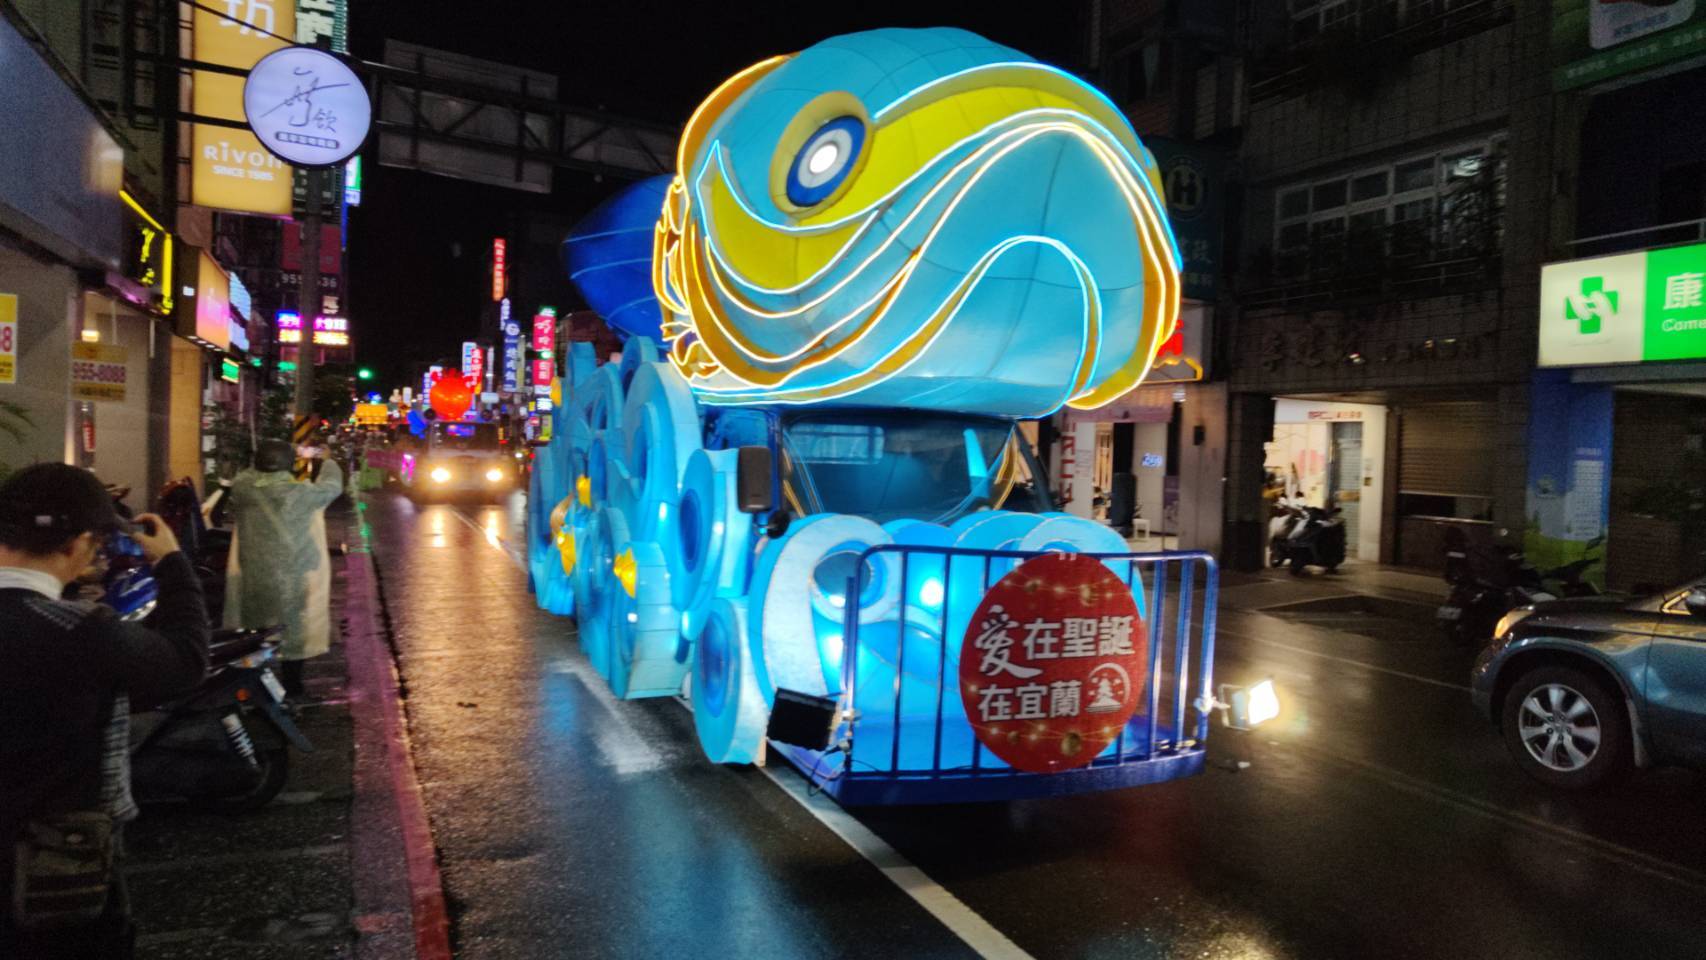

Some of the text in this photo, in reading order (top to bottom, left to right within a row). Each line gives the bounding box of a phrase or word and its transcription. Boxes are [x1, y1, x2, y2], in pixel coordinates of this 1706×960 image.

[1662, 272, 1706, 311] 康
[0, 325, 13, 353] 8
[977, 680, 1082, 722] 在宜蘭
